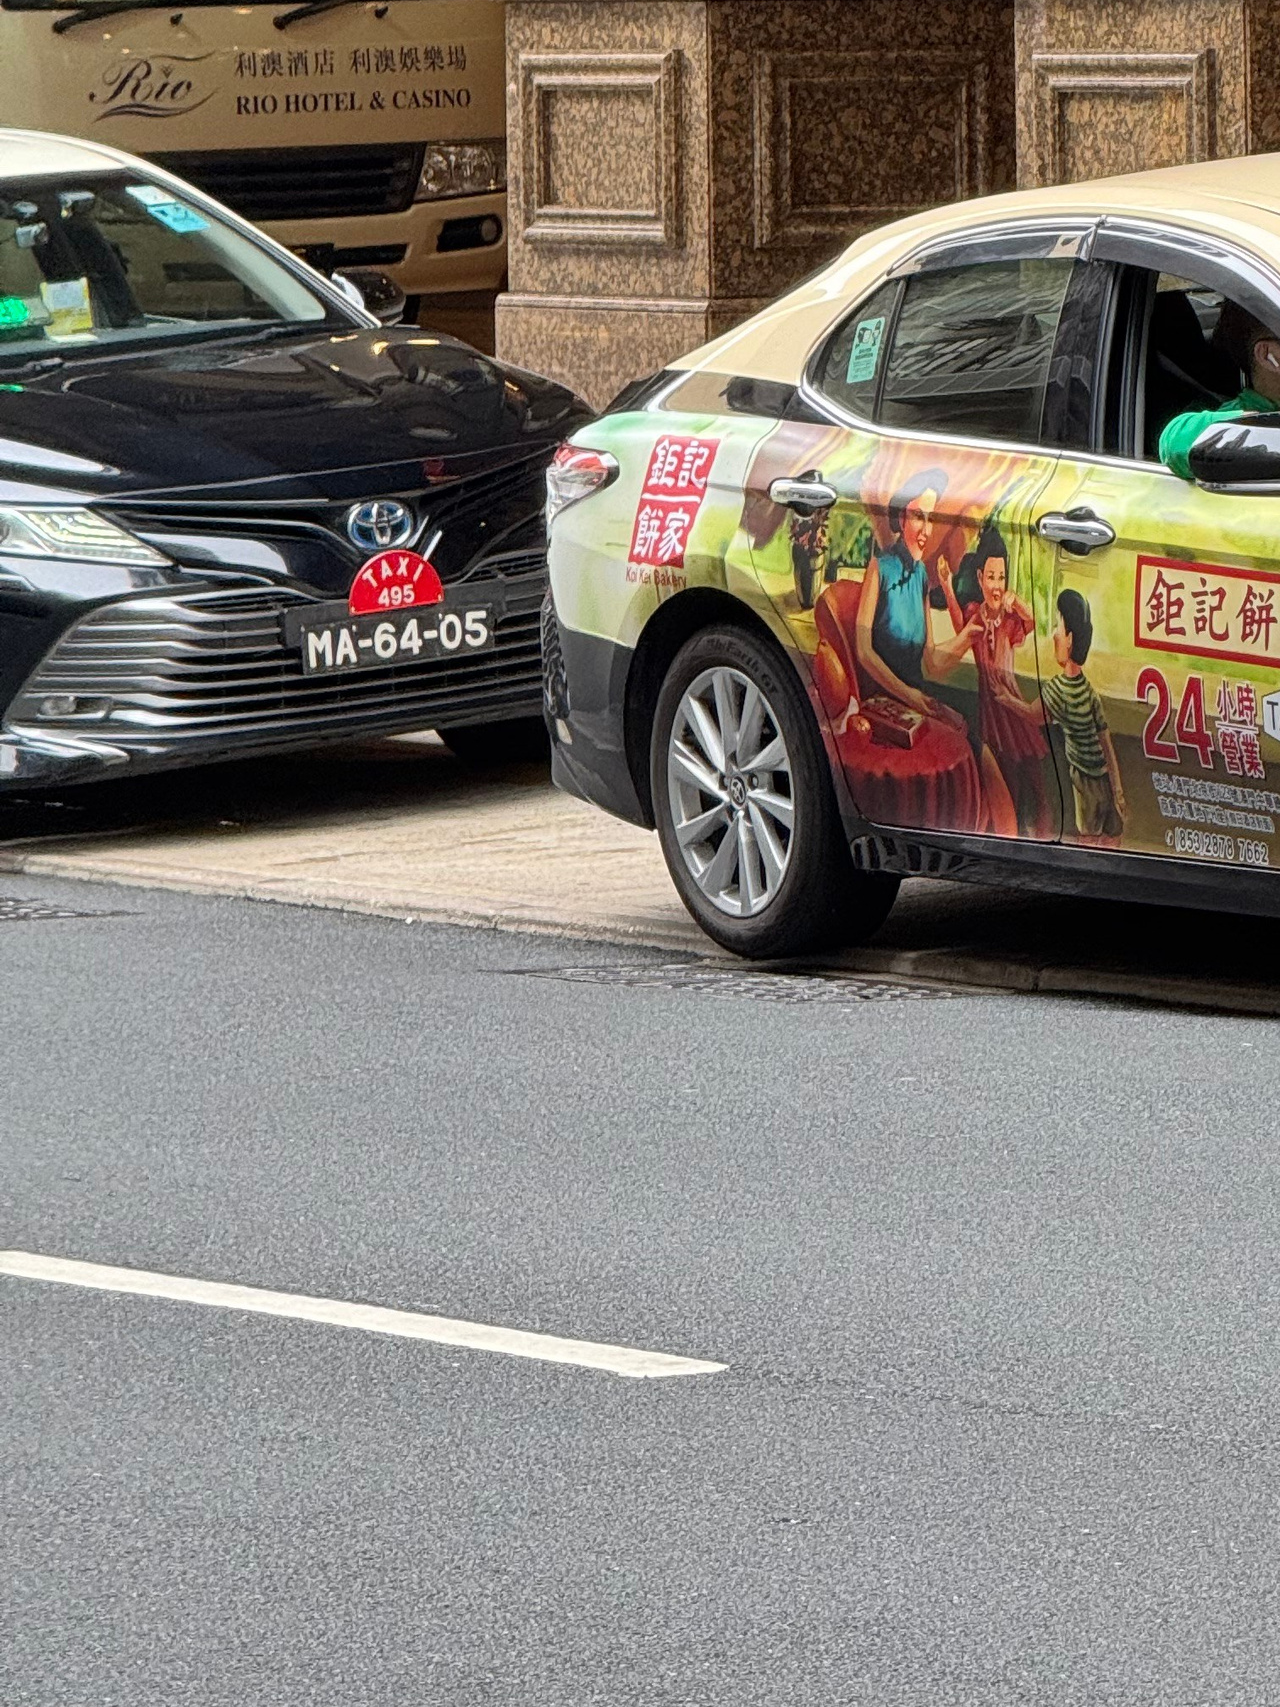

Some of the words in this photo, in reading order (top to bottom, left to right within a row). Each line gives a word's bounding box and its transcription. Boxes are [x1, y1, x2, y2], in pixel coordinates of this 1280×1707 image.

[233, 49, 335, 78] 利澳酒店
[235, 94, 278, 116] RIO
[284, 90, 363, 113] HOTEL
[369, 91, 386, 111] &
[392, 87, 472, 110] CASINO
[647, 439, 710, 488] 鉅記
[633, 504, 691, 562] 餅家
[361, 556, 424, 589] TAXI
[653, 568, 687, 590] Bakery
[377, 584, 416, 607] 495
[307, 610, 488, 669] MA-64-05
[1136, 665, 1215, 770] 24
[1216, 677, 1258, 729] 小時
[1218, 728, 1266, 780] 營業
[1174, 826, 1235, 860] (853)2878
[1237, 837, 1270, 866] 7662
